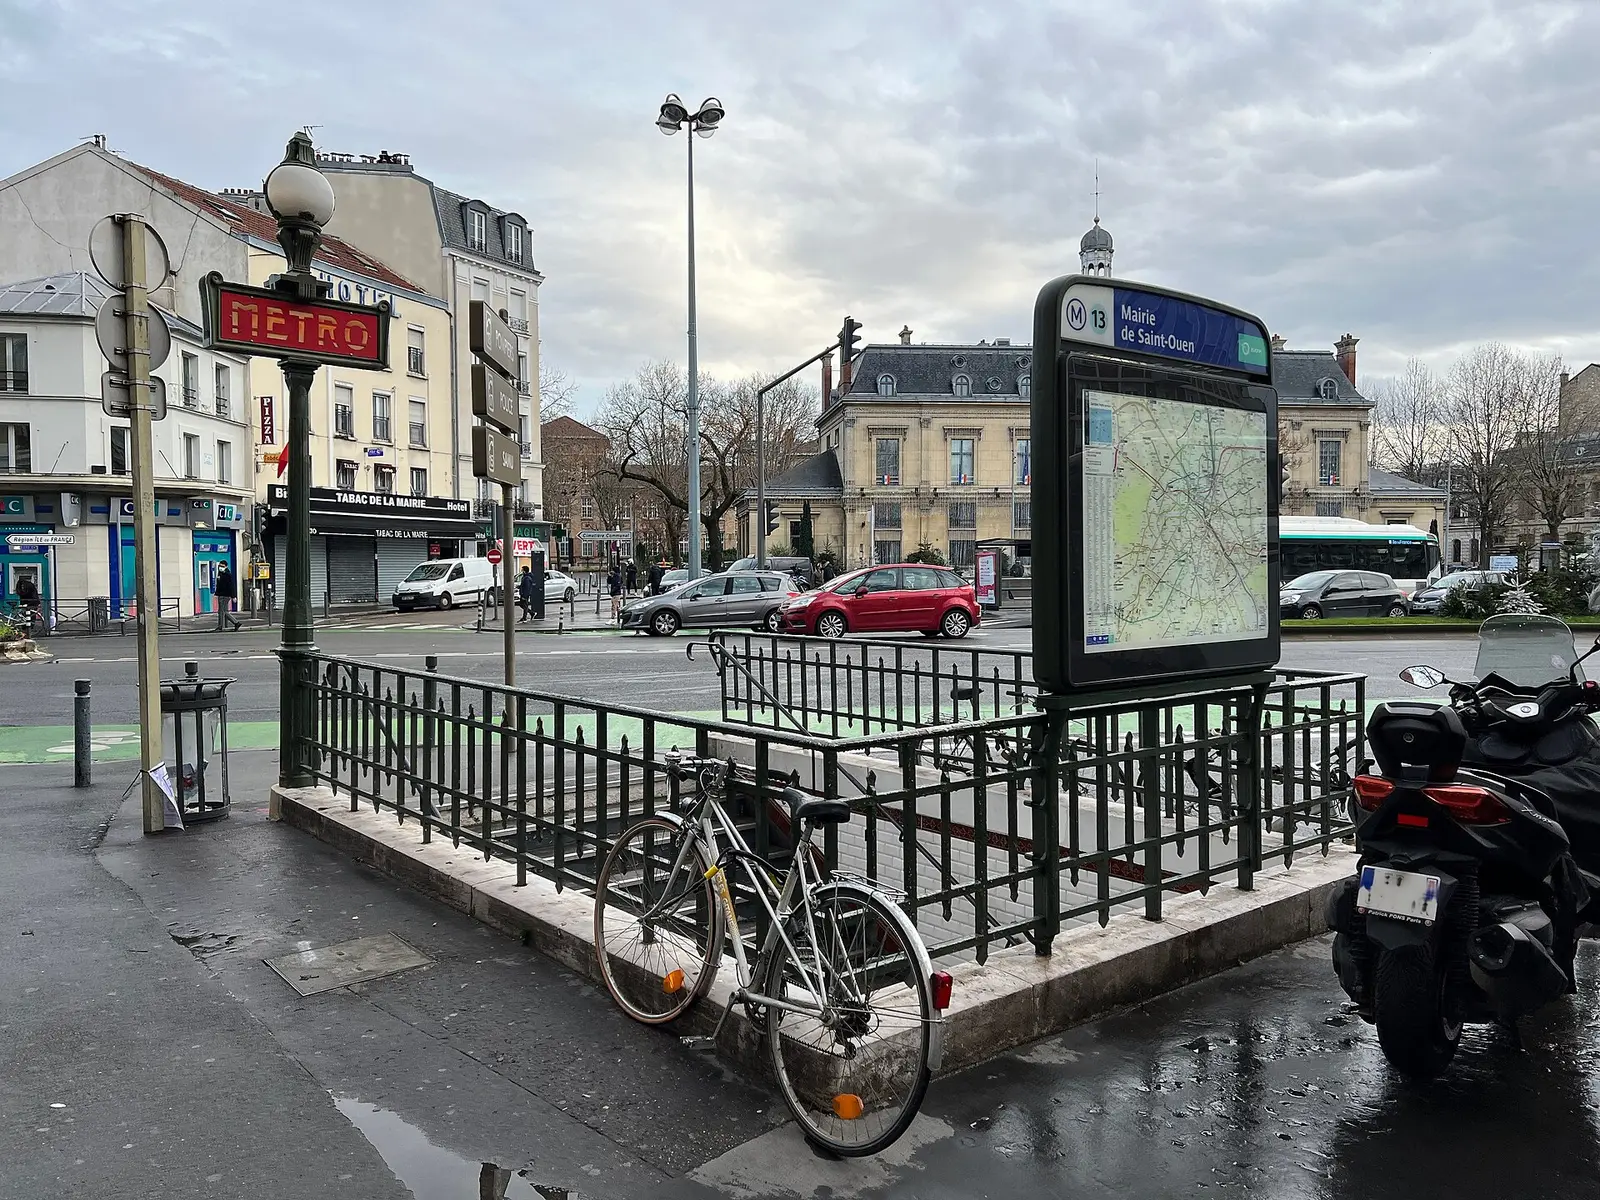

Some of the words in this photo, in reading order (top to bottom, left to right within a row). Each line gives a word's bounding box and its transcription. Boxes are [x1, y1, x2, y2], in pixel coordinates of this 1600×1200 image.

[1091, 309, 1106, 329] 13
[1121, 304, 1156, 326] Mairie
[232, 301, 369, 350] METRO
[1121, 325, 1134, 342] de
[1138, 328, 1195, 353] Saint-Ouen
[499, 391, 514, 415] POLICE
[263, 397, 271, 444] PIZZA
[194, 501, 209, 509] CIC
[336, 492, 368, 505] TABAC
[369, 495, 382, 506] DE
[383, 496, 395, 507] LA
[396, 498, 426, 509] MAIRIE
[447, 501, 467, 512] Hotel
[219, 506, 232, 519] CIC
[13, 536, 33, 544] Région
[1367, 909, 1388, 918] Patrick
[1406, 916, 1422, 924] Paris
